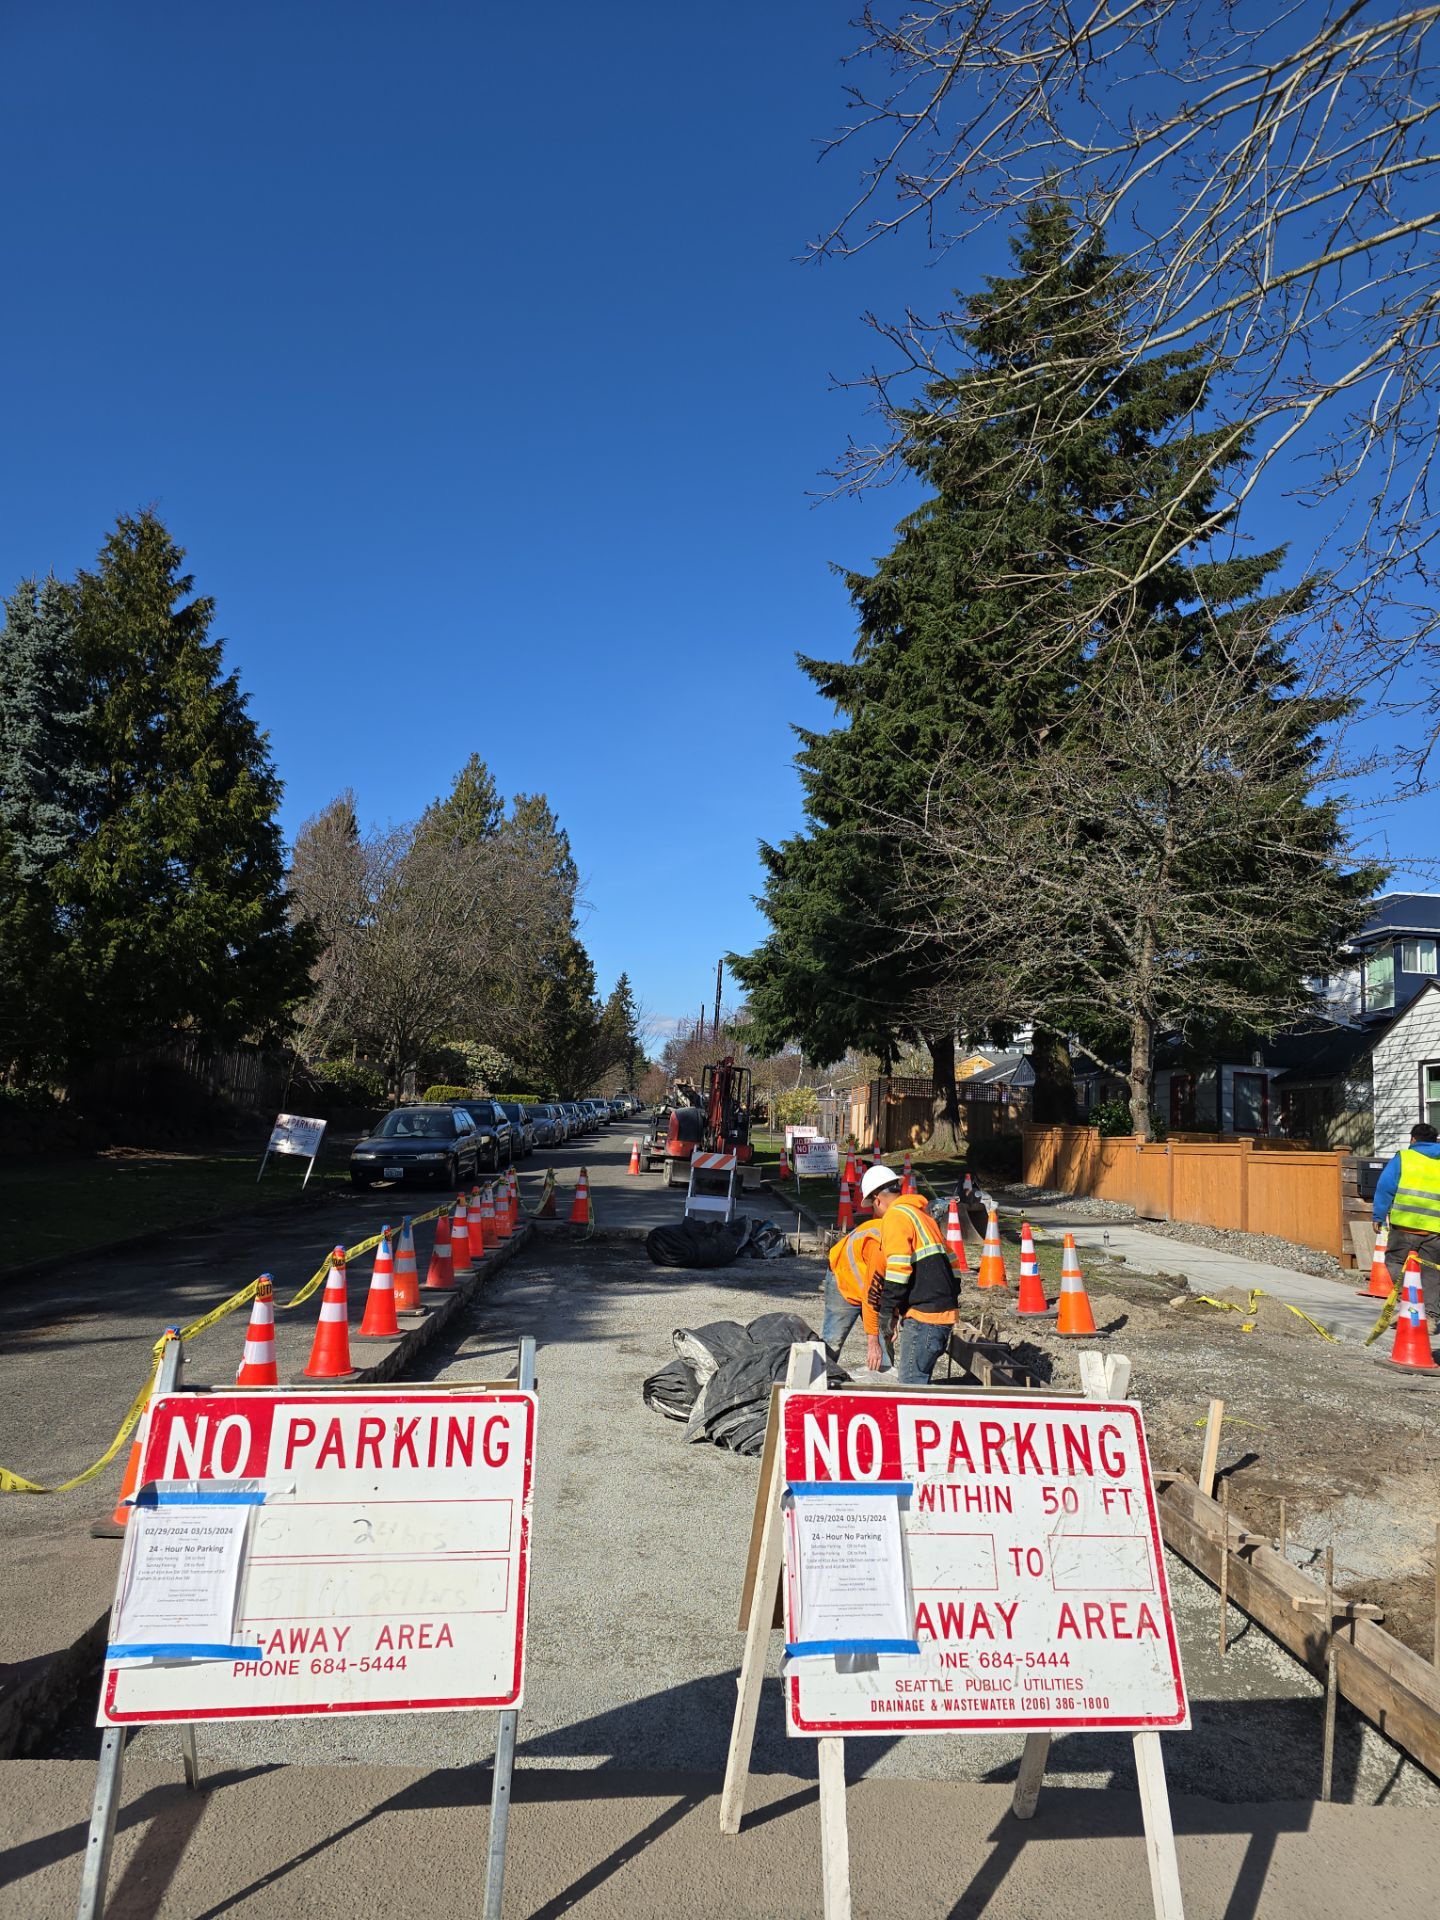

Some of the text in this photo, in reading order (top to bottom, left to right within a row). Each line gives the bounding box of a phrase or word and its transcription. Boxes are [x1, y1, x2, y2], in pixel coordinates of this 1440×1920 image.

[797, 1144, 836, 1153] NO PARKING
[163, 1414, 253, 1480] NO
[284, 1414, 512, 1471] PARKING
[804, 1413, 1126, 1482] NO PARKING
[918, 1484, 1133, 1516] WITHIN 50 FT
[804, 1514, 887, 1523] 02/29/2024 03/15/2024
[145, 1527, 234, 1536] 02/29/2024 03/15/2024
[812, 1533, 820, 1541] 24
[826, 1533, 843, 1541] Hour
[856, 1533, 882, 1541] Parking
[165, 1545, 183, 1553] Hour
[197, 1545, 224, 1554] Parking
[1009, 1547, 1045, 1577] TO
[1057, 1602, 1161, 1640] AREA
[375, 1623, 454, 1650] AREA
[232, 1656, 408, 1677] PHONE 684-5444
[979, 1651, 1071, 1669] 684-5444
[895, 1677, 1084, 1693] SEATTLE PUBLIC UTILITIES
[870, 1696, 1110, 1713] DRAINAGE & WASTEWATER (206) 386-1800
